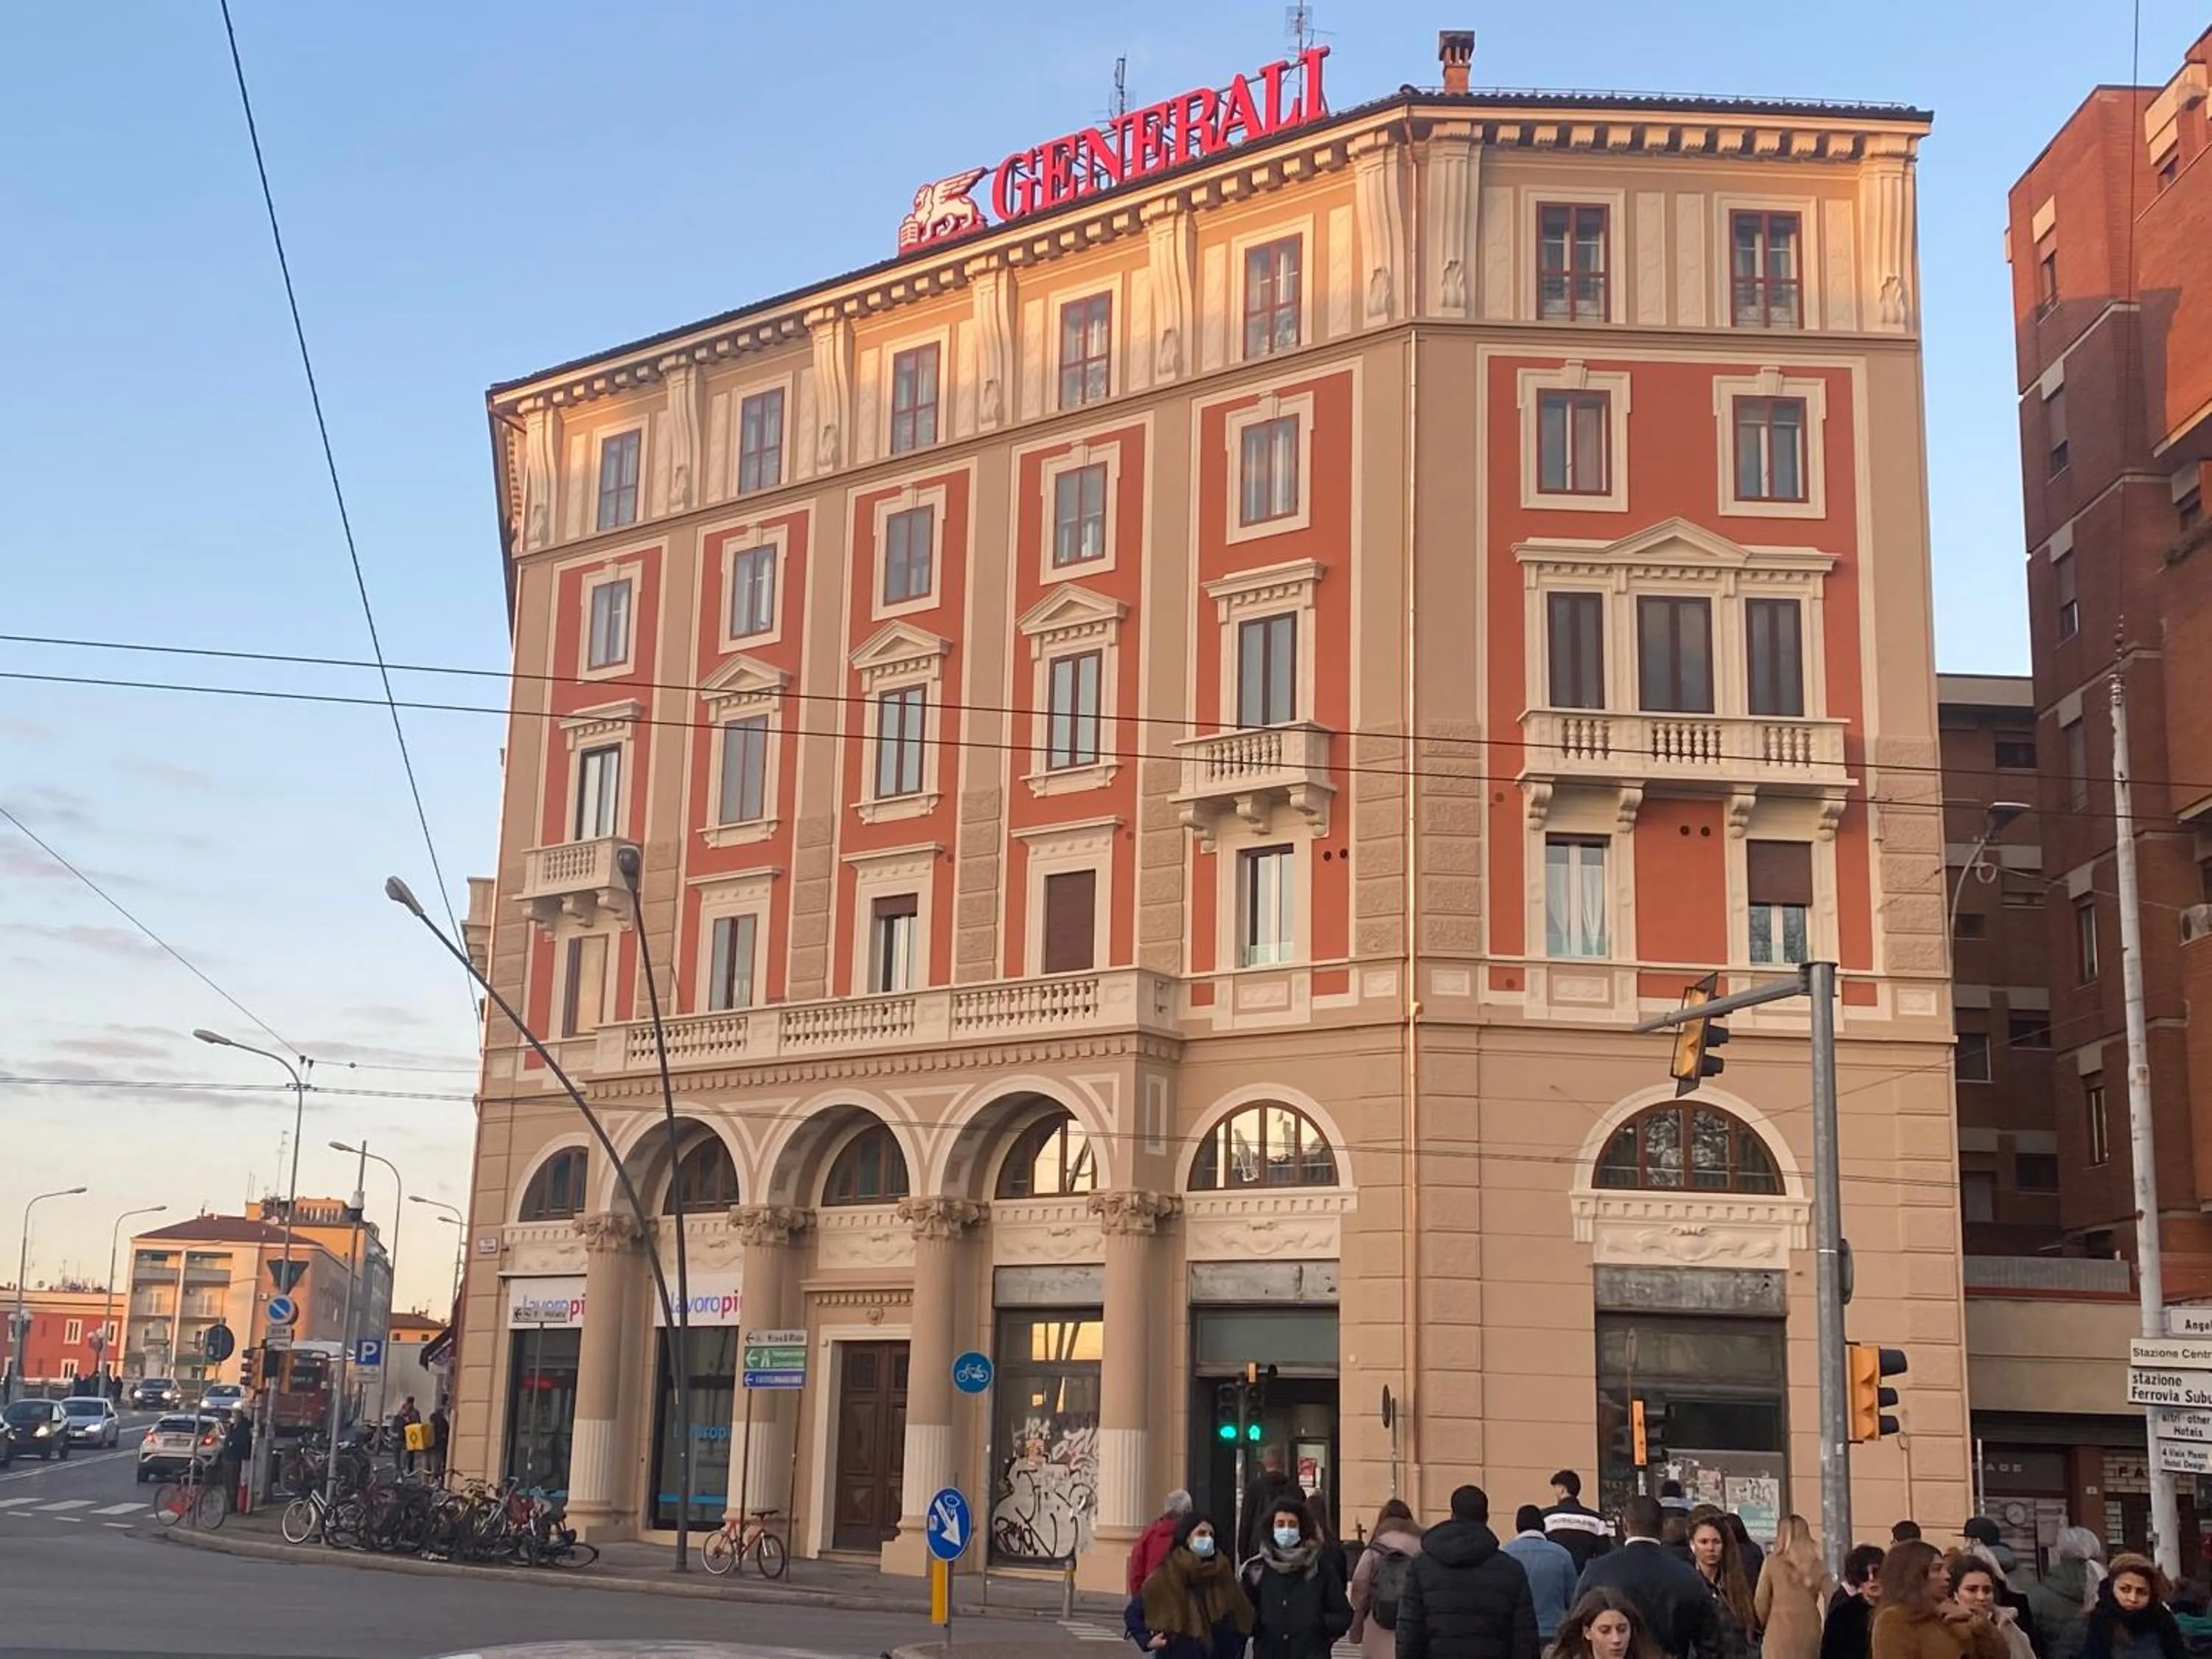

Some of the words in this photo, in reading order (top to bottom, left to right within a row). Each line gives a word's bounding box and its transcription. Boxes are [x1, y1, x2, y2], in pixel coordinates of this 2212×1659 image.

[991, 46, 1330, 223] GENERALI
[361, 1341, 378, 1363] P
[2132, 1347, 2178, 1357] Stazione
[2132, 1372, 2183, 1387] stazione
[2132, 1386, 2180, 1402] Ferrovia
